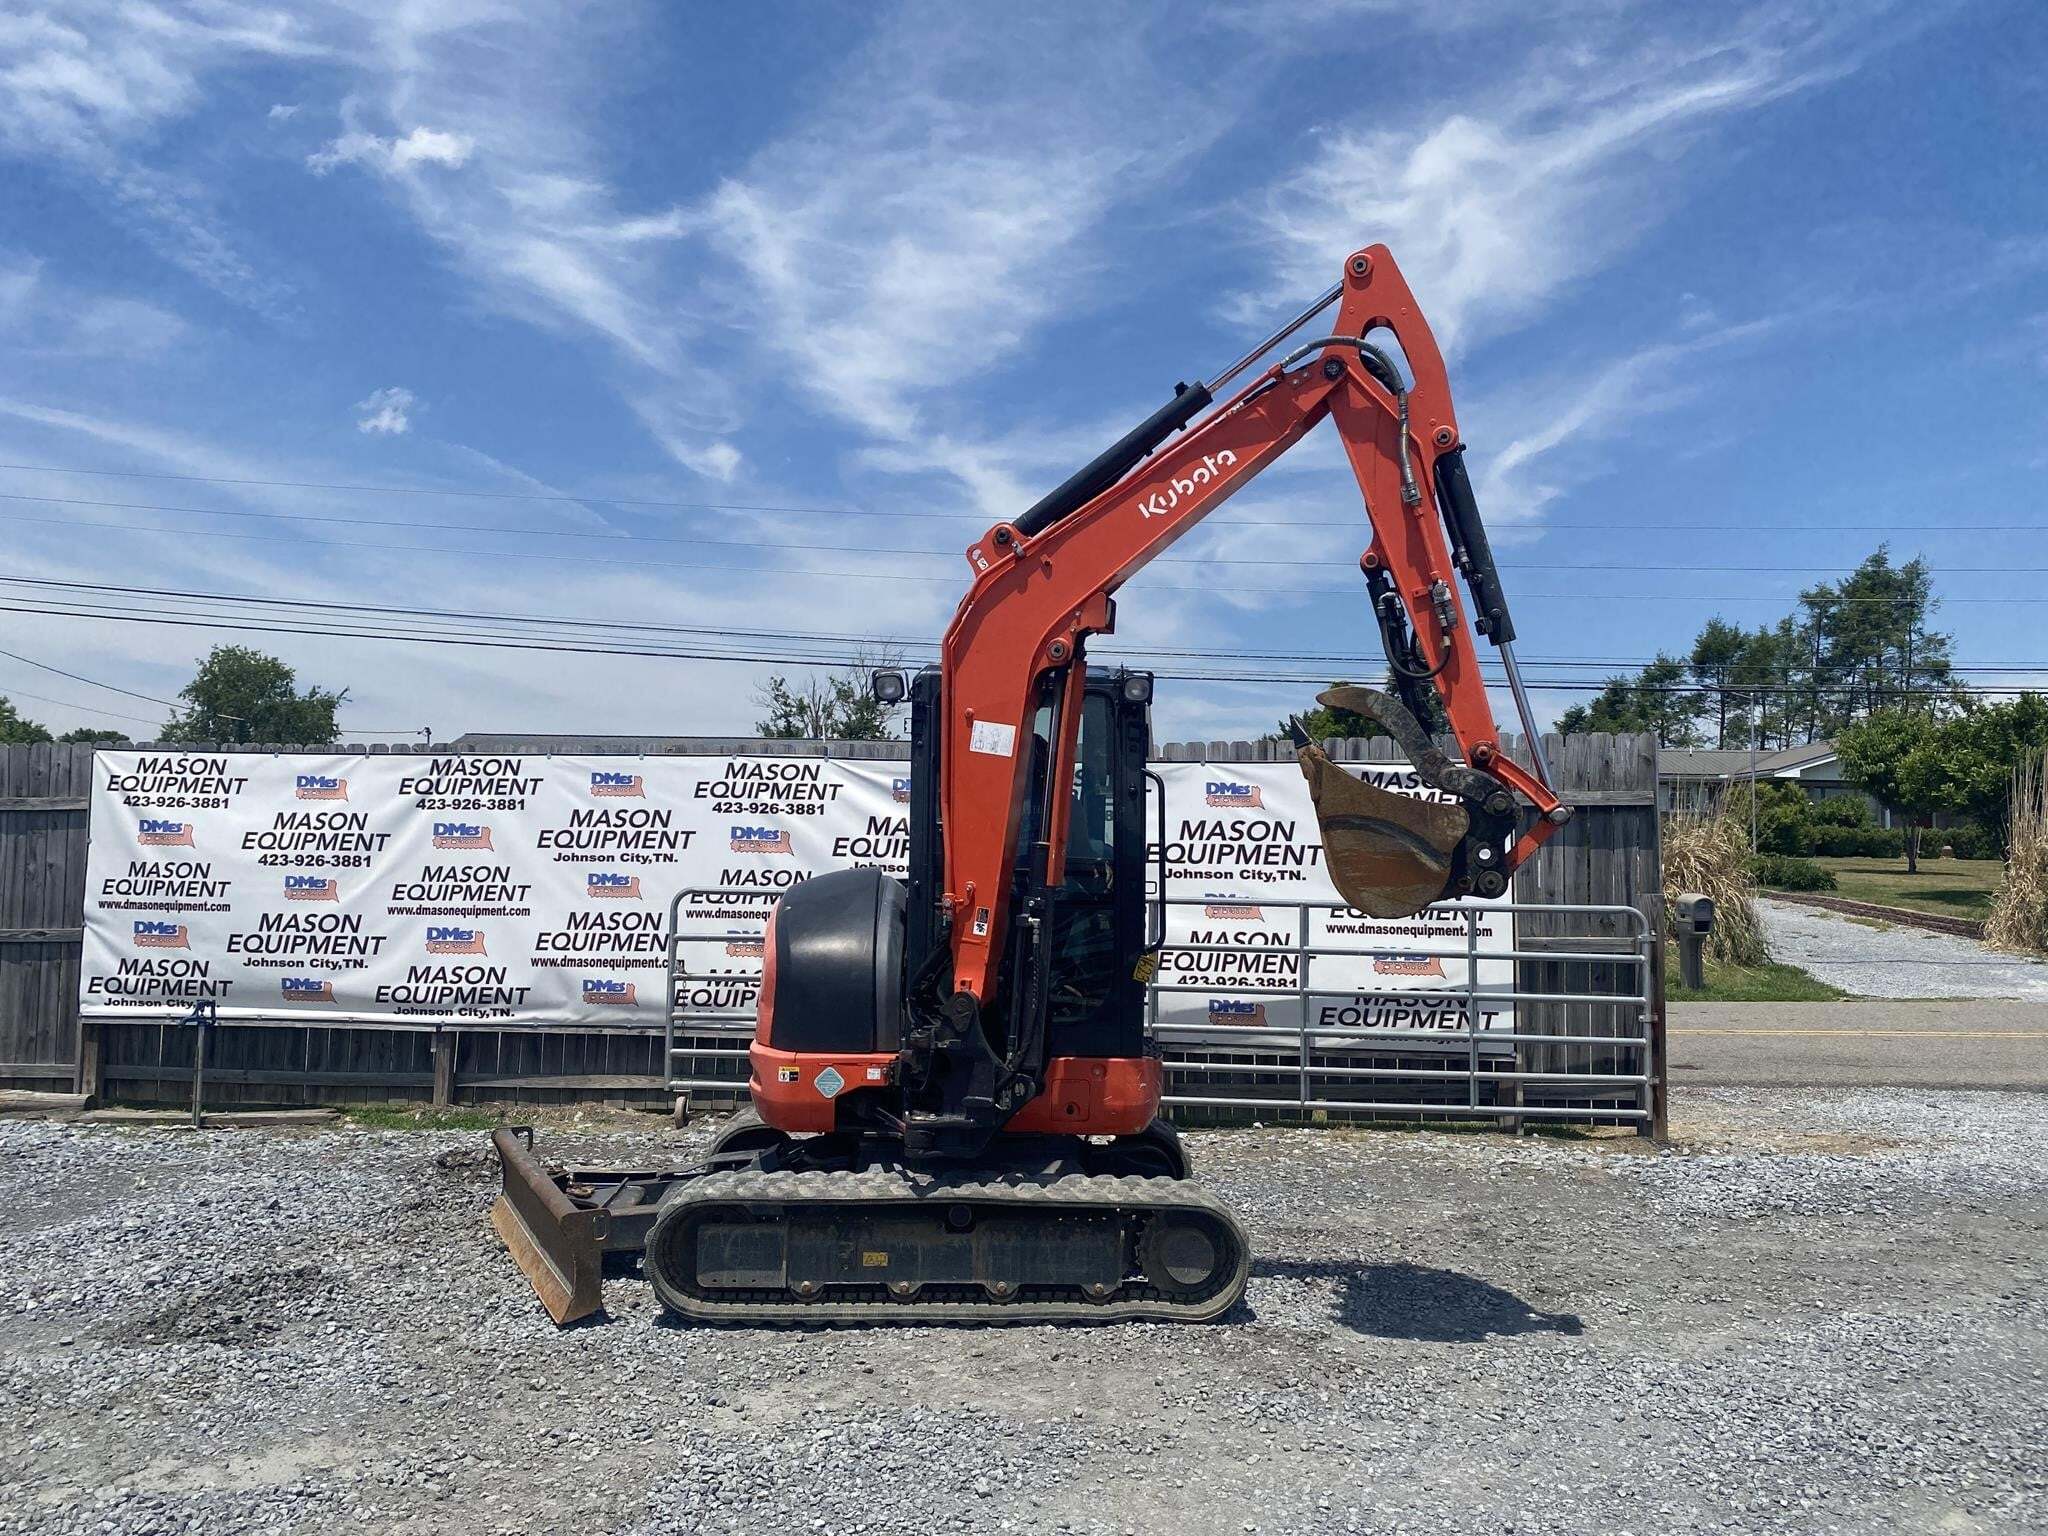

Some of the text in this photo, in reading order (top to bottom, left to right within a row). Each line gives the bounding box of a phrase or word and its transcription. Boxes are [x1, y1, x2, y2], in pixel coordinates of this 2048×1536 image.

[1138, 449, 1238, 519] Kubota
[136, 757, 228, 775] MASON
[428, 758, 522, 776] MASON
[724, 762, 821, 781] MASON
[106, 775, 248, 795] EQUIPMENT
[399, 777, 544, 796] EQUIPMENT
[1361, 771, 1437, 789] MAS
[693, 781, 844, 801] EQUIPMENT
[122, 795, 230, 809] 423-926-3881
[415, 798, 526, 811] 423-926-3881
[711, 802, 826, 815] 423-926-3881
[273, 812, 369, 830] MASON
[568, 808, 672, 828] MASON
[536, 829, 697, 849] EQUIPMENT
[1180, 820, 1296, 841] MASON
[241, 831, 391, 852] EQUIPMENT
[257, 854, 372, 868] 423-926-3881
[552, 852, 616, 863] Johnson
[128, 861, 211, 879] MASON
[420, 865, 511, 882] MASON
[1164, 868, 1234, 880] Johnson
[102, 878, 231, 898] EQUIPMENT
[391, 883, 531, 902] EQUIPMENT
[98, 900, 231, 913] www.dmasonequipment.com
[387, 904, 531, 918] www.dmasonequipment.com
[258, 912, 362, 933] MASON
[566, 911, 663, 931] MASON
[1325, 923, 1493, 938] www.dmasonequipment.om
[226, 934, 387, 955] EQUIPMENT
[535, 932, 670, 952] EQUIPMEN
[117, 957, 210, 977] MASON
[243, 957, 305, 969] Johnson
[406, 965, 508, 985] MASON
[87, 976, 234, 997] EQUIPMENT
[375, 985, 531, 1005] EQUIPMENT
[103, 997, 162, 1007] Johnson
[393, 1006, 454, 1017] Johnson
